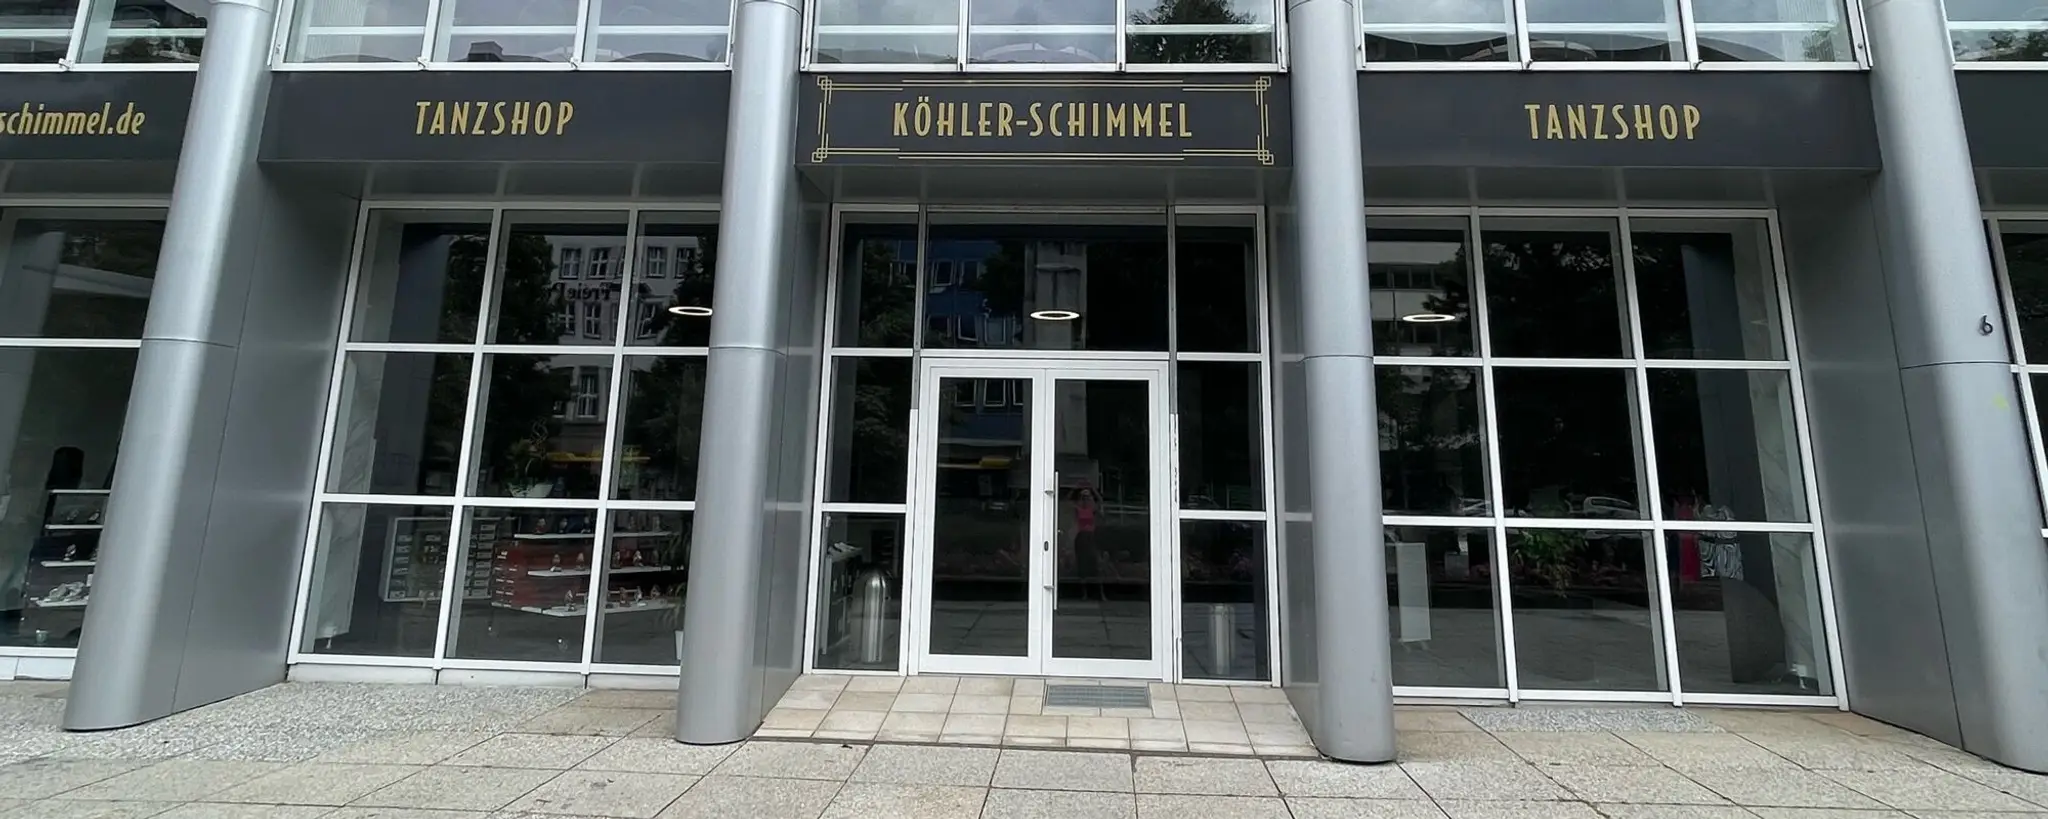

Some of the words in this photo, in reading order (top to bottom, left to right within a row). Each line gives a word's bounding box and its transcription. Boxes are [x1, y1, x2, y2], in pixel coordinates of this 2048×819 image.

[416, 101, 574, 135] TANZSHOP
[892, 96, 1193, 137] KÖHLER-SCHIMMEL
[1524, 104, 1701, 140] TANZSHOP
[1980, 314, 1994, 336] 6
